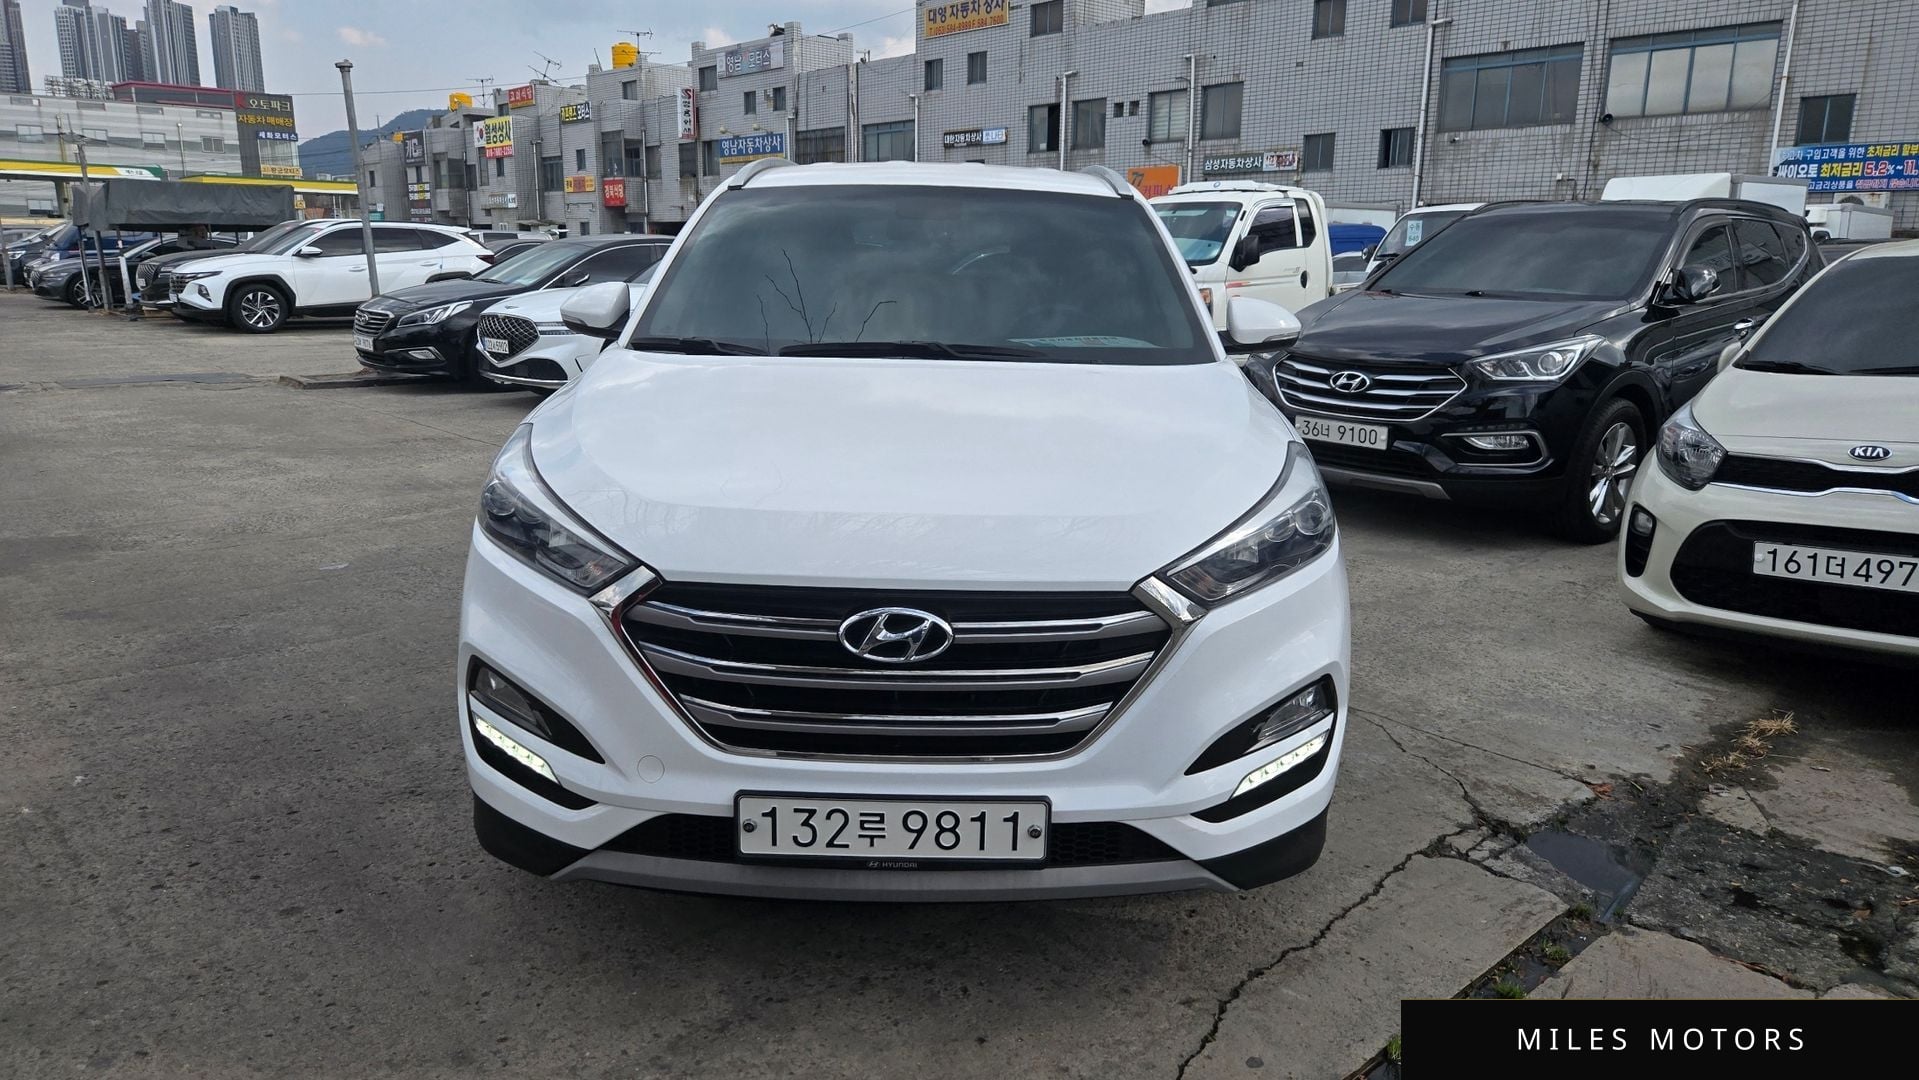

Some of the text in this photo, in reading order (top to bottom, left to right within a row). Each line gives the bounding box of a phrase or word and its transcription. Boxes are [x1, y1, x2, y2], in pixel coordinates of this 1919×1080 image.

[928, 7, 947, 24] 대영
[249, 98, 291, 112] 오토파크
[721, 136, 781, 156] 영남자동차상사
[1806, 148, 1846, 160] 구입고객을
[1848, 147, 1865, 158] 위한
[1866, 144, 1900, 157] 초저금리
[1205, 155, 1263, 170] 삼성자동차상사
[1777, 163, 1818, 178] 싸이오토
[1820, 161, 1863, 178] 최저금리
[1302, 420, 1378, 445] 36너 9100
[1854, 446, 1884, 458] KIA
[1767, 548, 1846, 579] 161더
[761, 806, 1020, 851] 132루 9811
[882, 861, 918, 869] HYUNDAI
